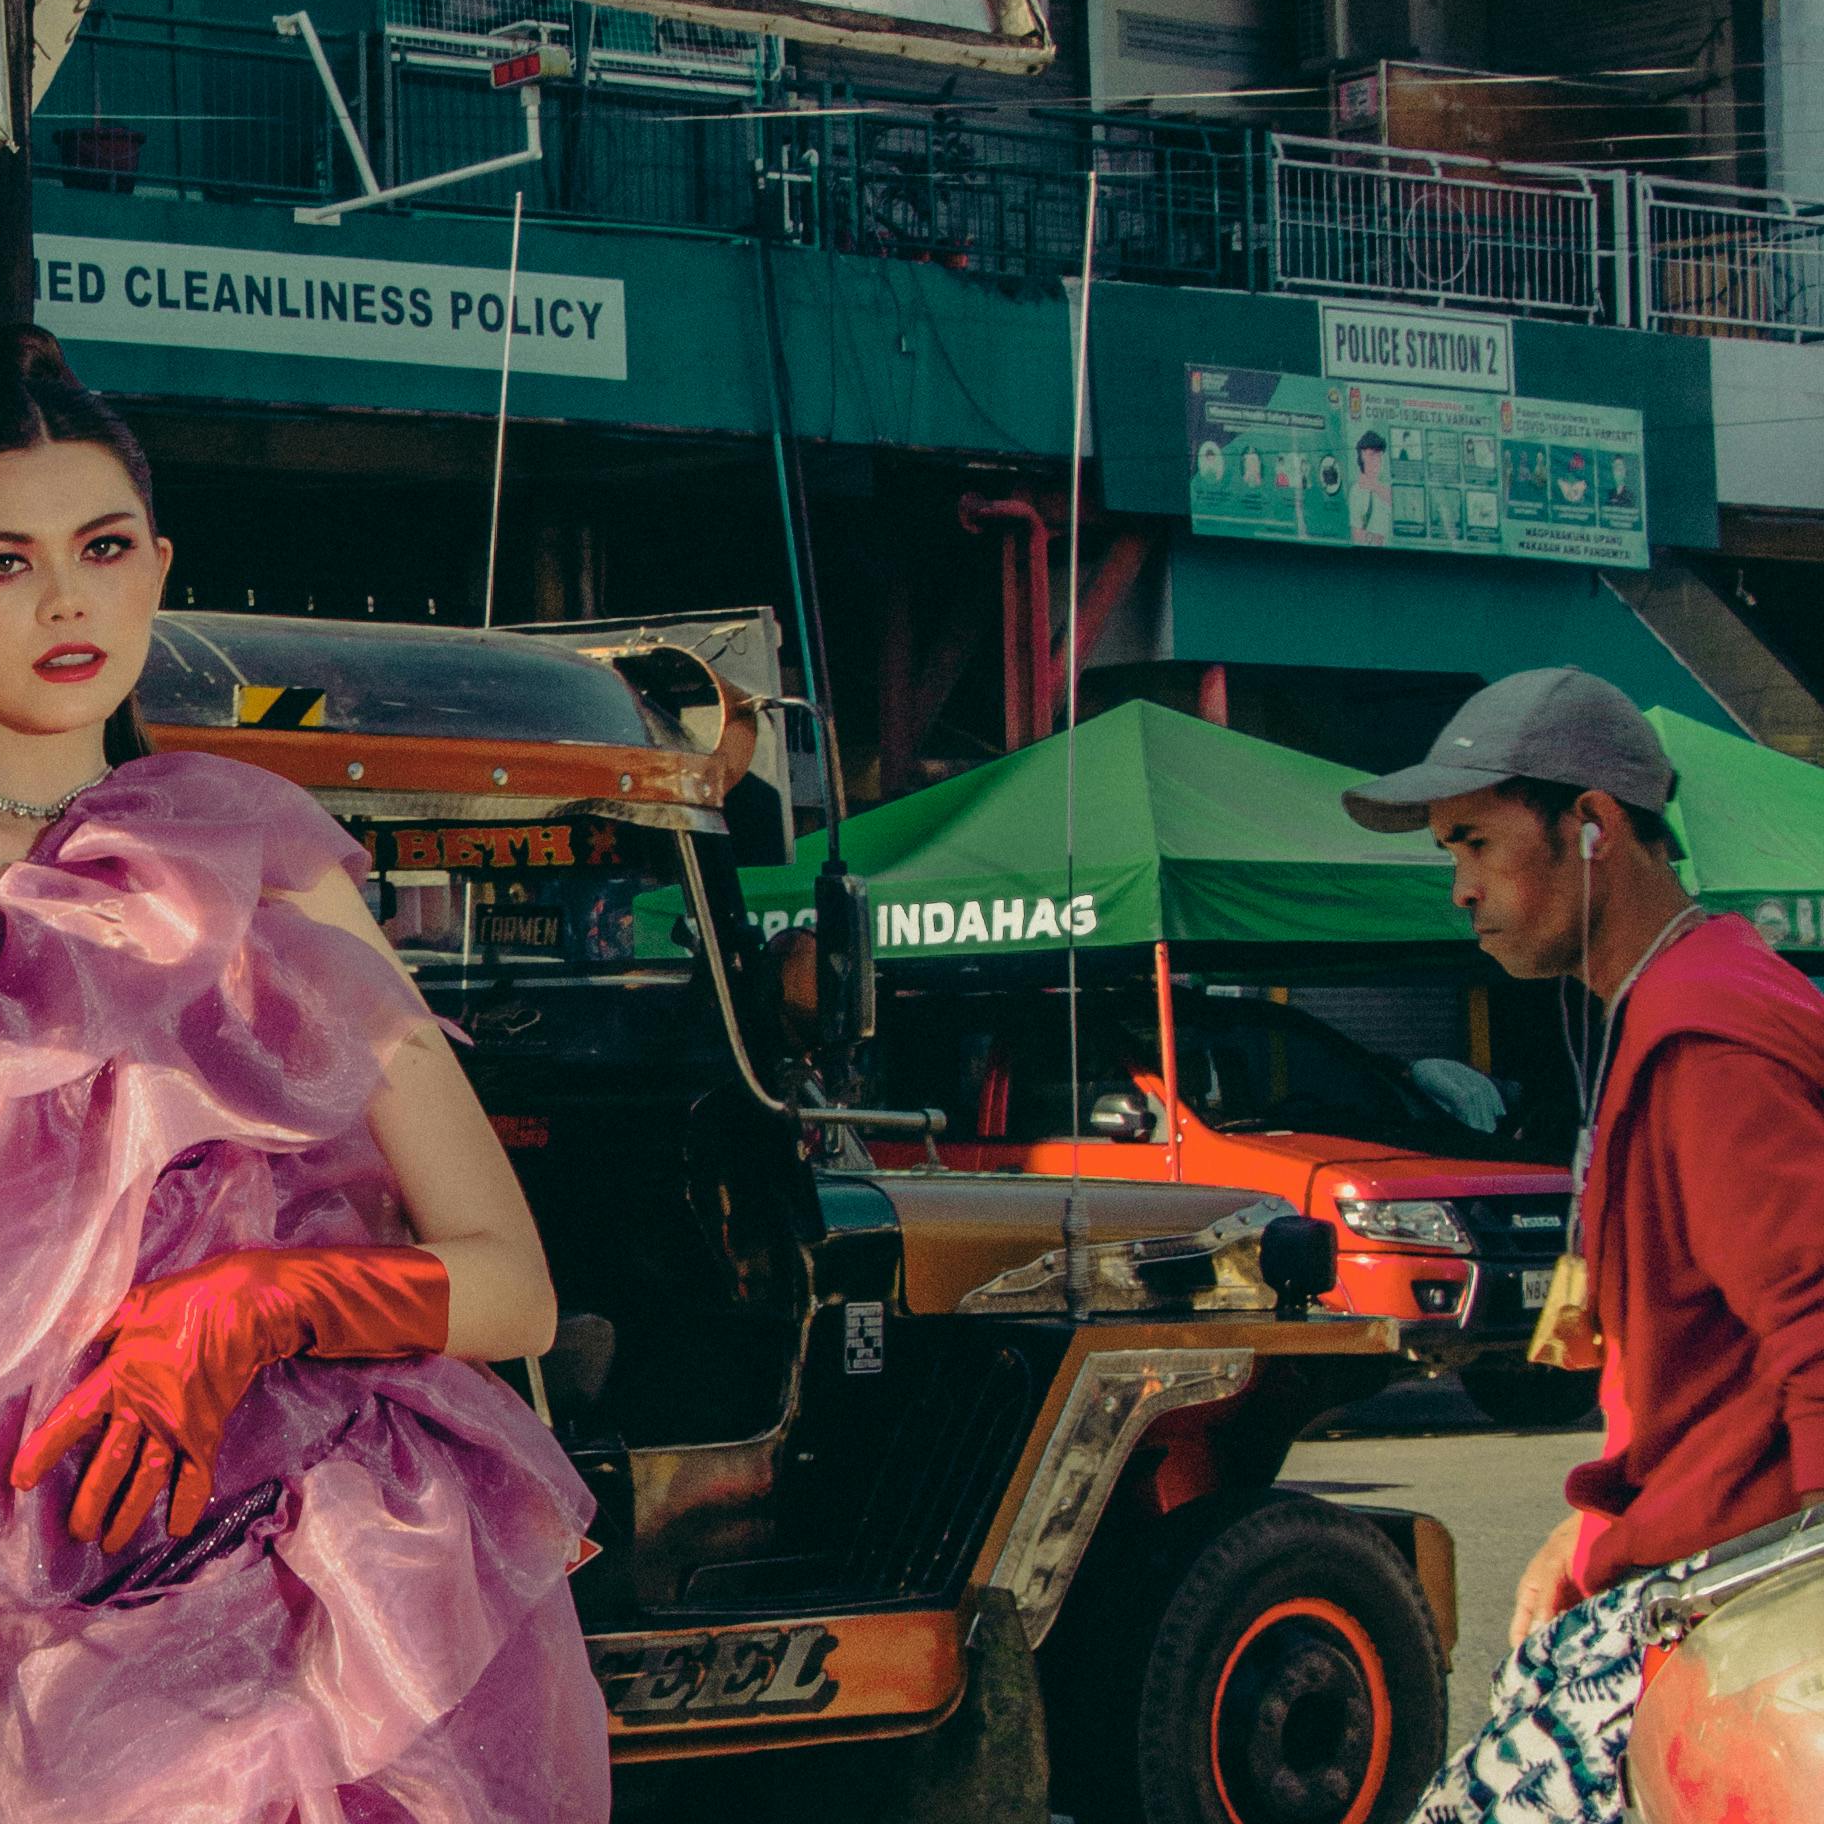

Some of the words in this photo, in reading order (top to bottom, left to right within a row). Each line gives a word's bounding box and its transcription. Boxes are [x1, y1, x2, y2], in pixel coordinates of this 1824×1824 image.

[124, 265, 434, 329] CLEANLINESS
[449, 291, 604, 341] POLICY
[1335, 323, 1401, 366] POLICE
[1405, 328, 1481, 374] STATION
[1485, 336, 1497, 375] 2
[392, 825, 576, 869] BETH
[877, 893, 1099, 948] INDAHAG
